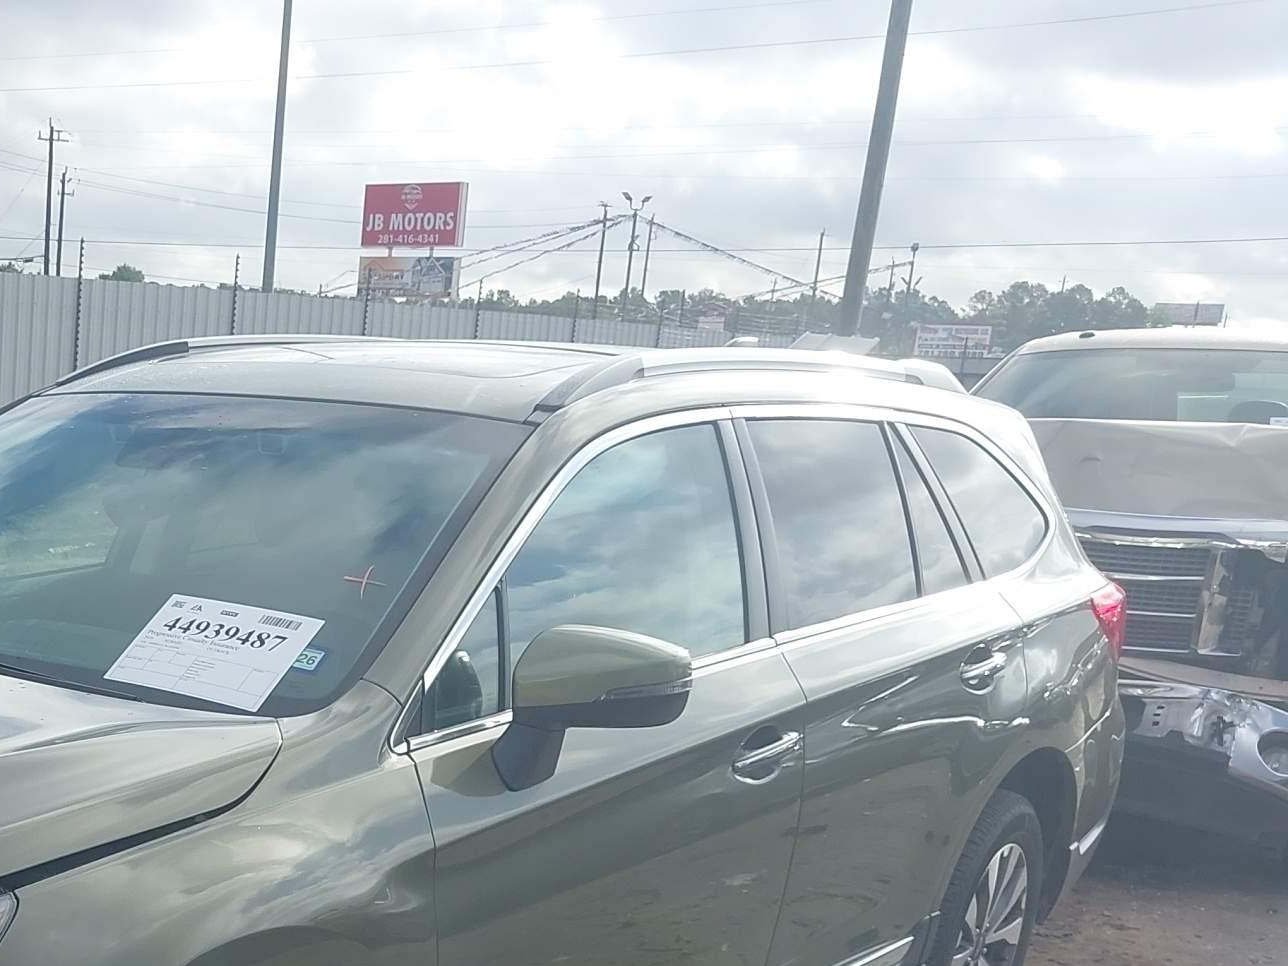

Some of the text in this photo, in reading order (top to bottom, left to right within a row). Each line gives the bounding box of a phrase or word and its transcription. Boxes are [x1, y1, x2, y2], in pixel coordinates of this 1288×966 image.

[366, 212, 455, 231] JB MOTORS
[163, 616, 289, 652] 44939487
[296, 653, 318, 666] 26
